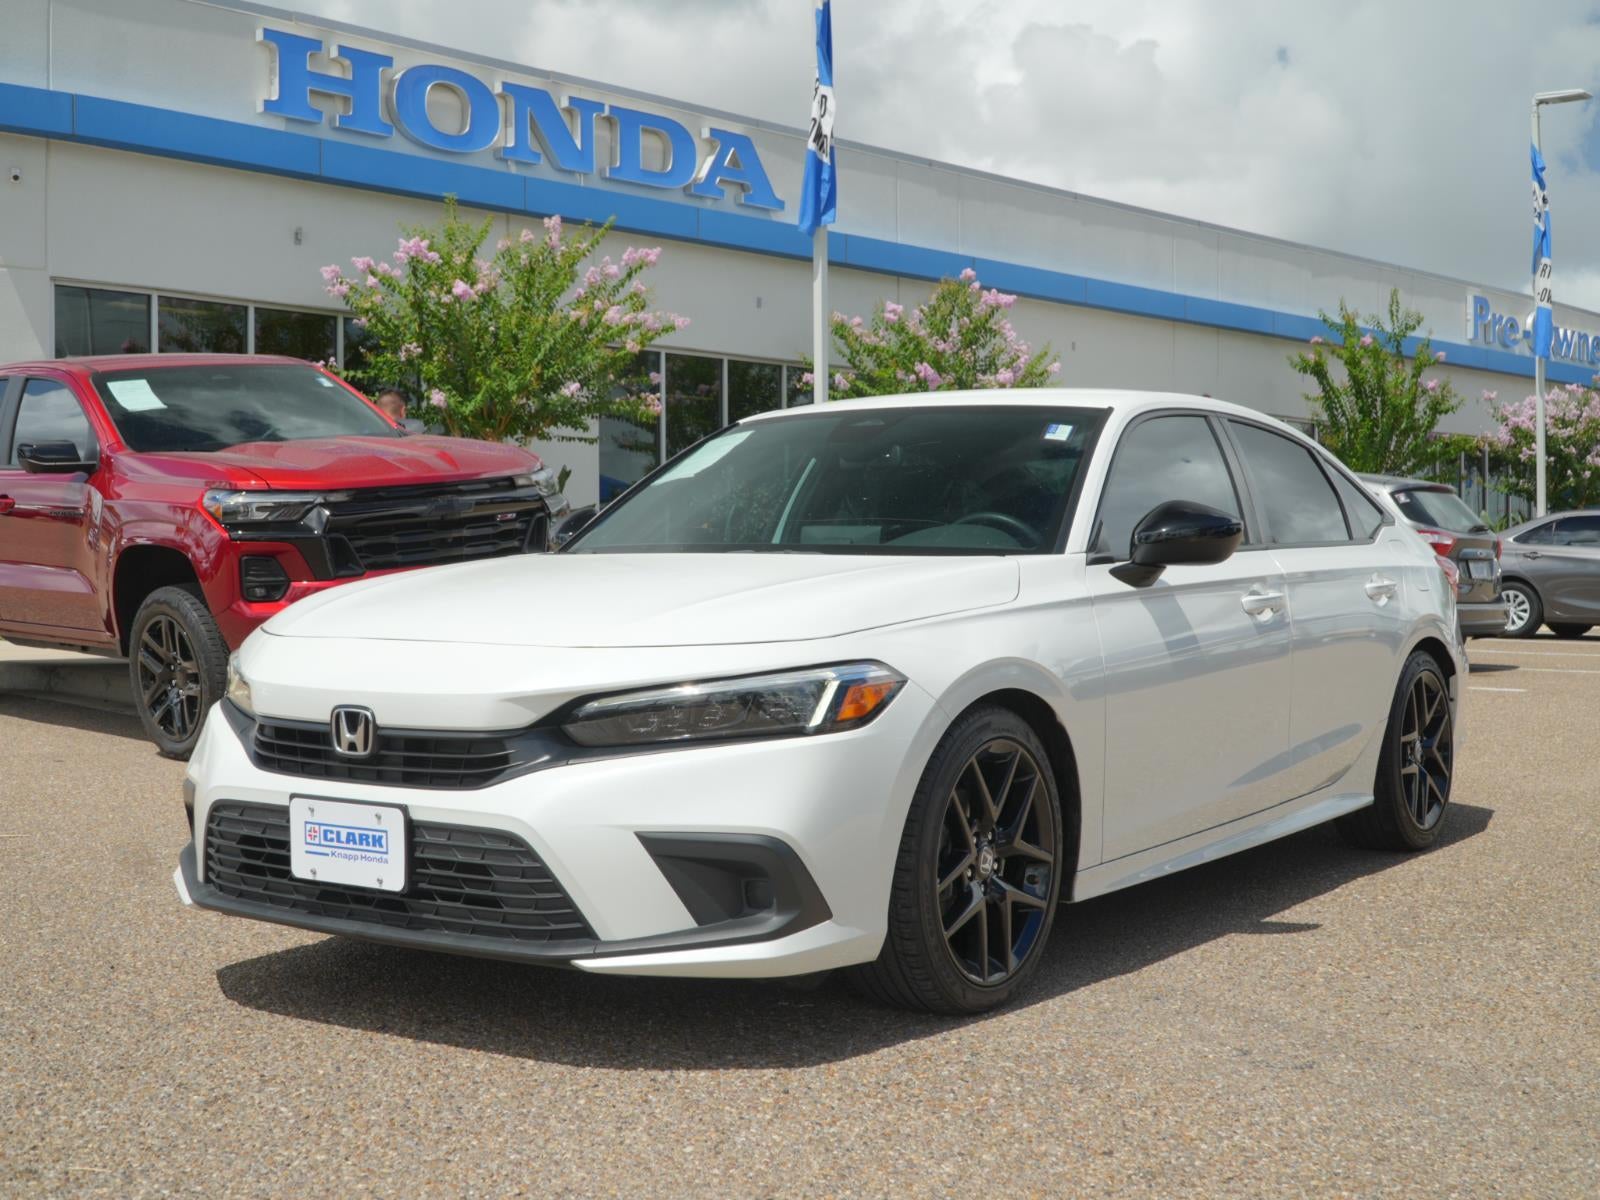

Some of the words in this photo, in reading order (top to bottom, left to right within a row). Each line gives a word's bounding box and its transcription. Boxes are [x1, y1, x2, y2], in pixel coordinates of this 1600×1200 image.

[259, 27, 785, 211] HONDA
[1469, 294, 1600, 366] Pre-wne
[322, 829, 384, 848] CLARK
[331, 850, 359, 861] Knapp
[360, 854, 389, 864] Honda
